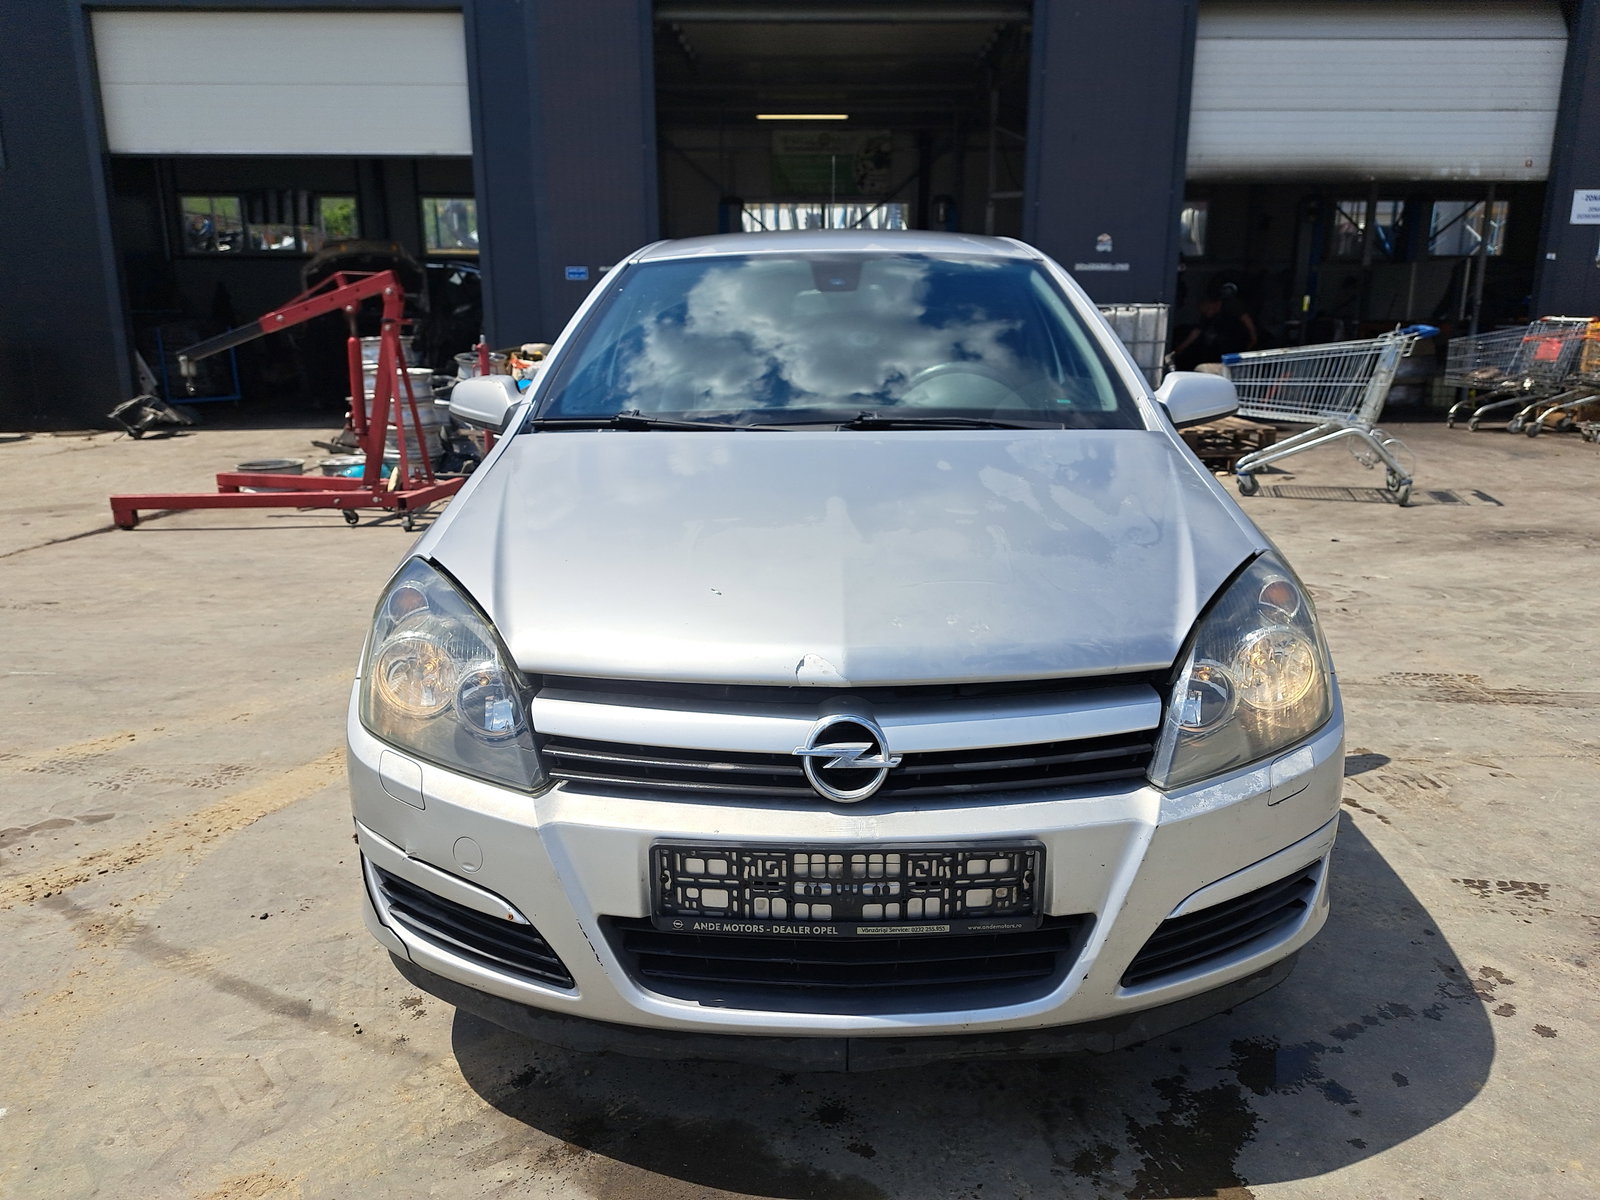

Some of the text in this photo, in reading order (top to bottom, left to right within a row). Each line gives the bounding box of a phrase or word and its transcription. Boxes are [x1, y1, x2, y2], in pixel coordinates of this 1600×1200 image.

[693, 922, 720, 931] ANDE
[722, 923, 764, 933] MOTORS
[772, 925, 811, 934] DEALER
[812, 926, 838, 935] OPEL
